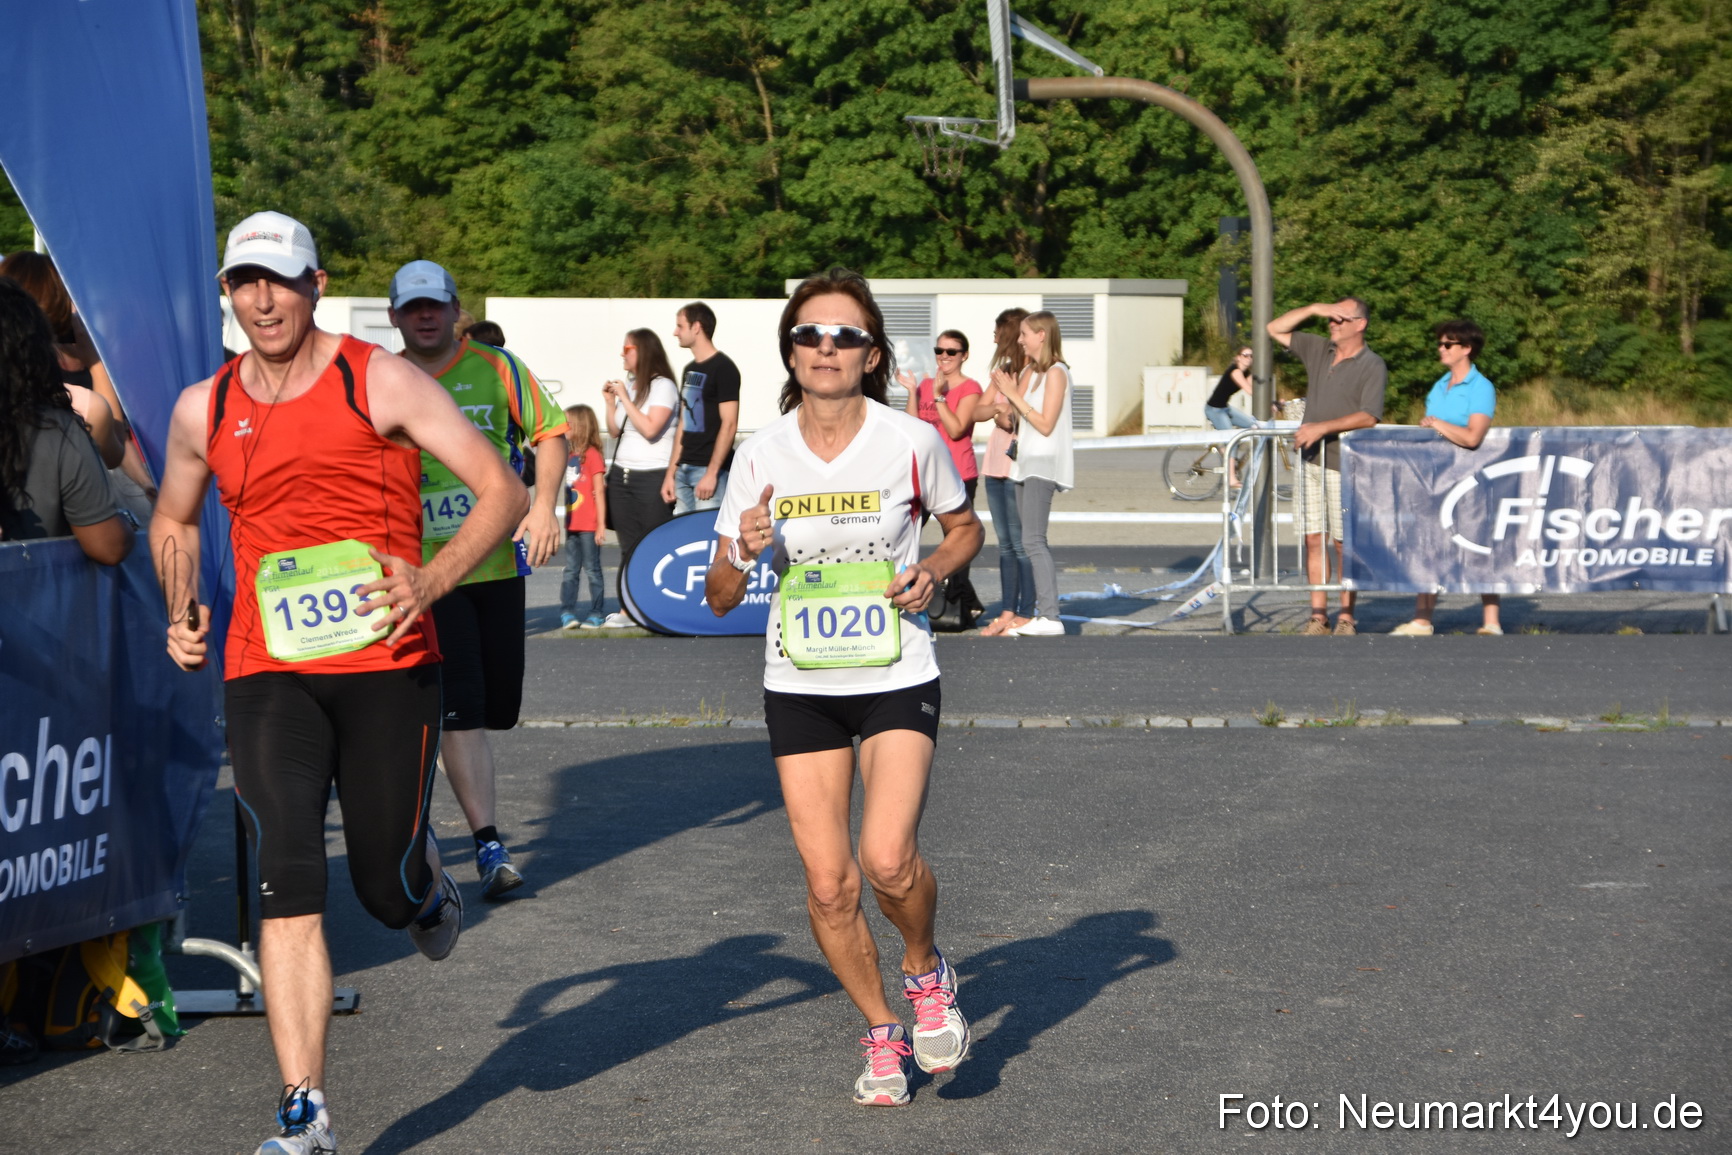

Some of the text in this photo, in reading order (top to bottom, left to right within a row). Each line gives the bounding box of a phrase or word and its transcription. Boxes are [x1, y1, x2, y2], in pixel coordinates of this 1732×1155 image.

[778, 494, 871, 517] ONLINE
[830, 515, 881, 526] Germany
[1493, 496, 1732, 541] Fischer
[1515, 546, 1715, 568] AUTOMOBILE
[272, 565, 314, 580] firmenlauf
[797, 581, 837, 590] firmenlauf
[274, 583, 374, 632] 1393
[794, 603, 886, 640] 1020
[300, 627, 358, 644] Clemens Wrede
[806, 644, 876, 654] Margit Müller-Münch
